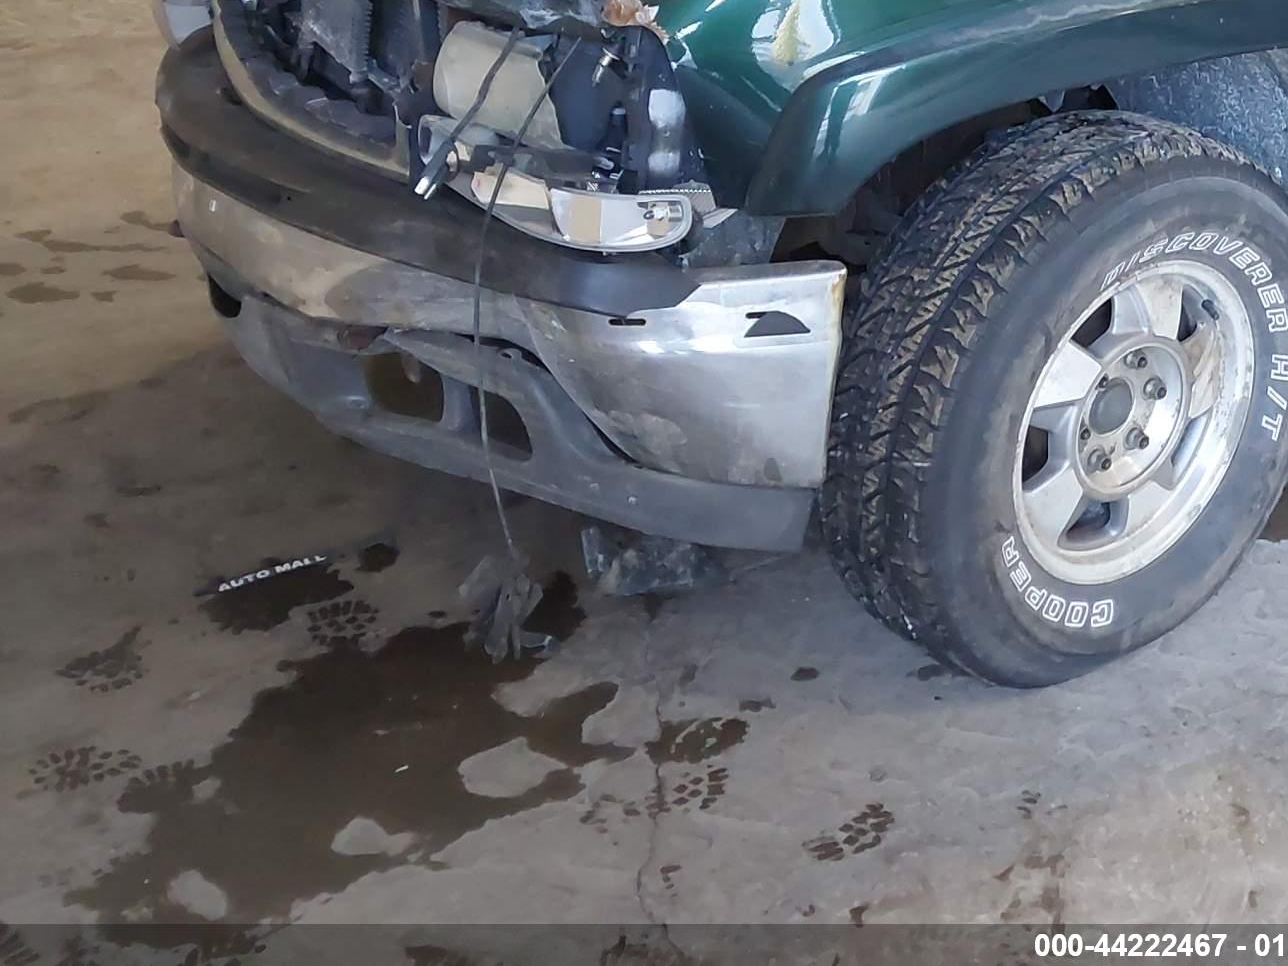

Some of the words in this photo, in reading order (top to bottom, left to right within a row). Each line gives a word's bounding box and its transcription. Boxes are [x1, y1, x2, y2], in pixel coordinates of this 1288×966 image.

[1100, 232, 1288, 333] DISCOVERER
[218, 569, 270, 592] AUTO
[274, 554, 327, 574] MALL
[1001, 535, 1114, 627] COOPER
